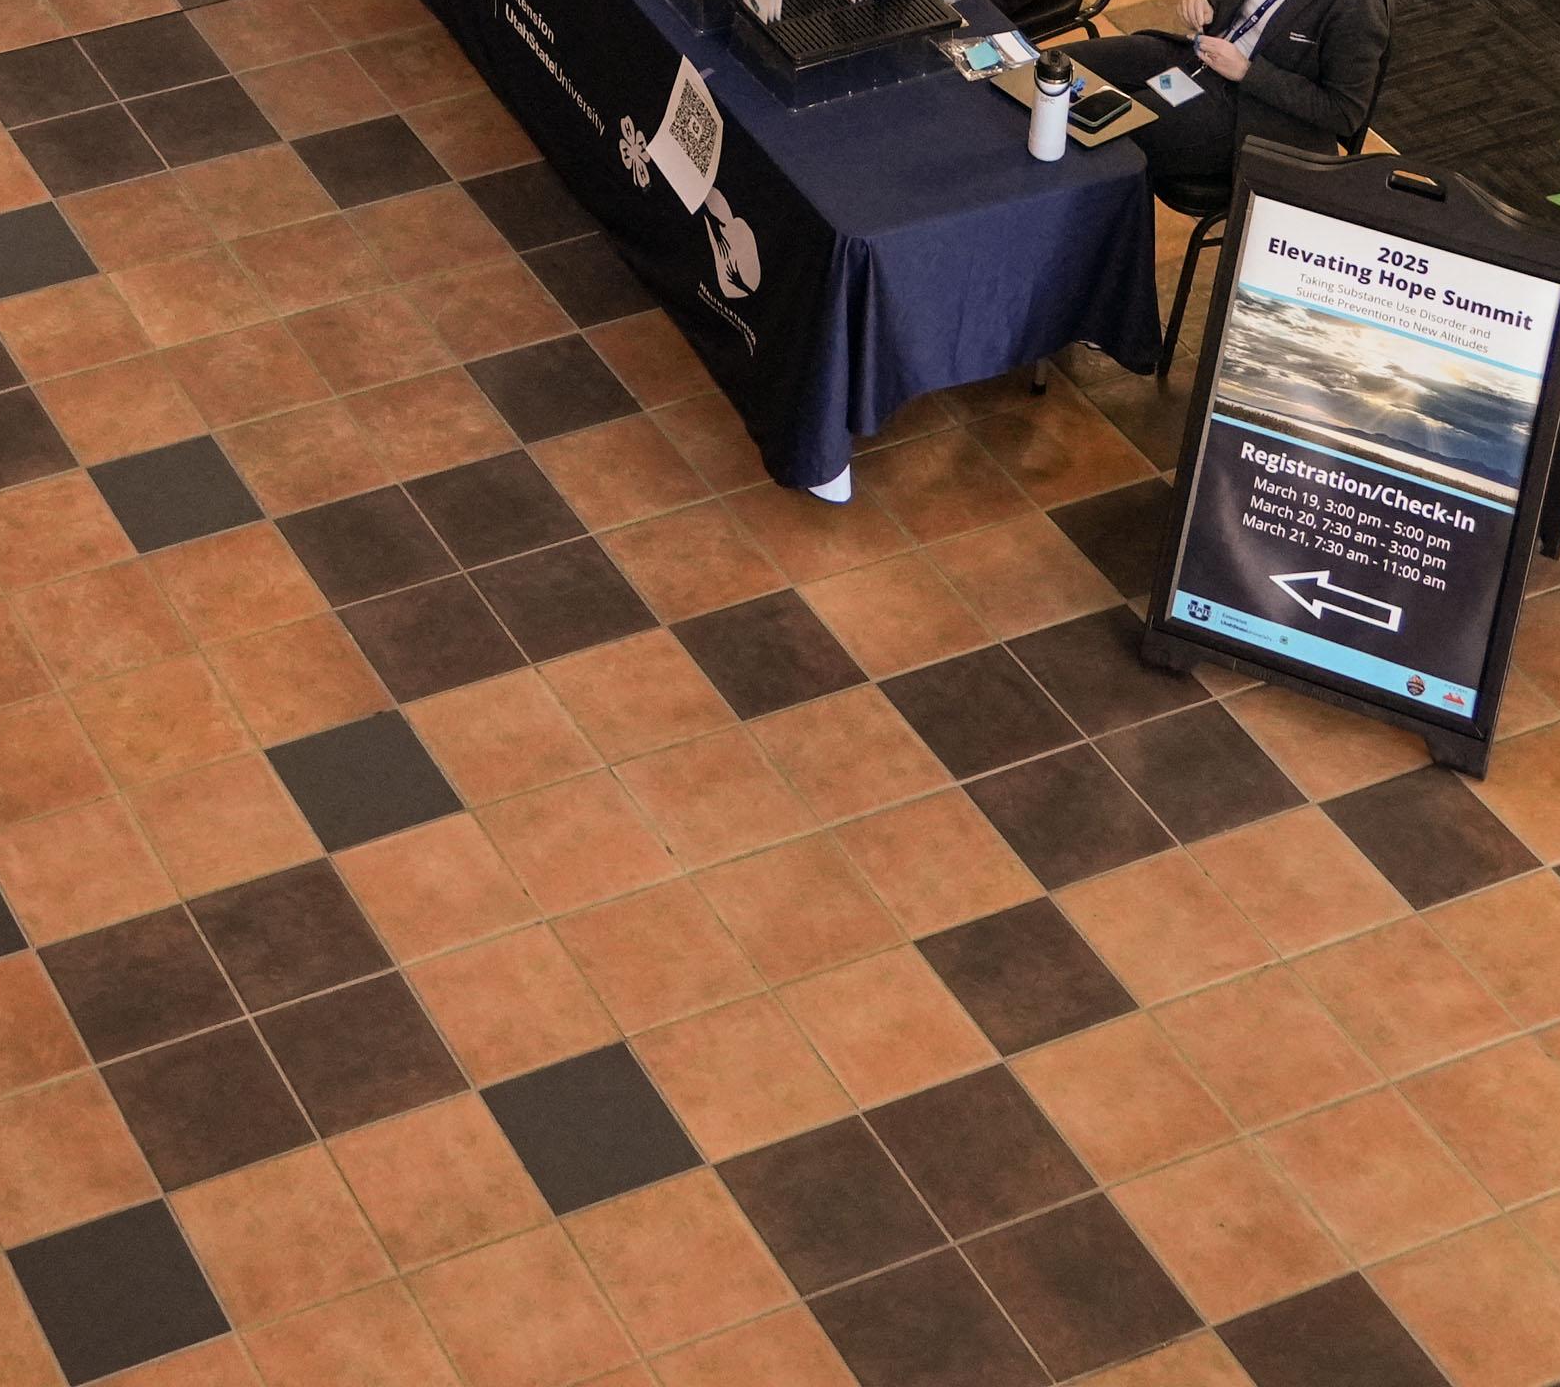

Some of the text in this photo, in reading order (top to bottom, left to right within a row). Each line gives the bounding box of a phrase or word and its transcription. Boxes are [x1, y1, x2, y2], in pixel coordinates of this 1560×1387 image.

[505, 3, 605, 137] UtahStateUniversity
[699, 281, 722, 308] HEALTH
[1268, 237, 1533, 331] Elevating Hope Summit
[1377, 247, 1429, 275] 2025
[1296, 286, 1489, 354] Suicide Prevention to New Altitudes
[1300, 273, 1491, 339] Taking Substance Use Disorder and
[1241, 441, 1476, 532] Registration/Check-In
[1254, 476, 1297, 502] March
[1302, 492, 1320, 511] 19,
[1324, 498, 1355, 520] 3:00
[1358, 511, 1381, 528] pm
[1393, 521, 1424, 542] 5:00
[1426, 534, 1451, 552] pm
[1242, 513, 1286, 538] March
[1288, 528, 1309, 547] 21,
[1314, 535, 1344, 556] 7:30
[1346, 549, 1369, 566] am
[1382, 558, 1420, 582] 11:00
[1422, 575, 1446, 591] am
[1250, 495, 1294, 521] March
[1296, 511, 1316, 530] 20,
[1322, 517, 1352, 539] 7:30
[1354, 531, 1377, 548] am
[1388, 540, 1419, 561] 3:00
[1422, 553, 1446, 571] pm
[1186, 603, 1211, 619] STATE
